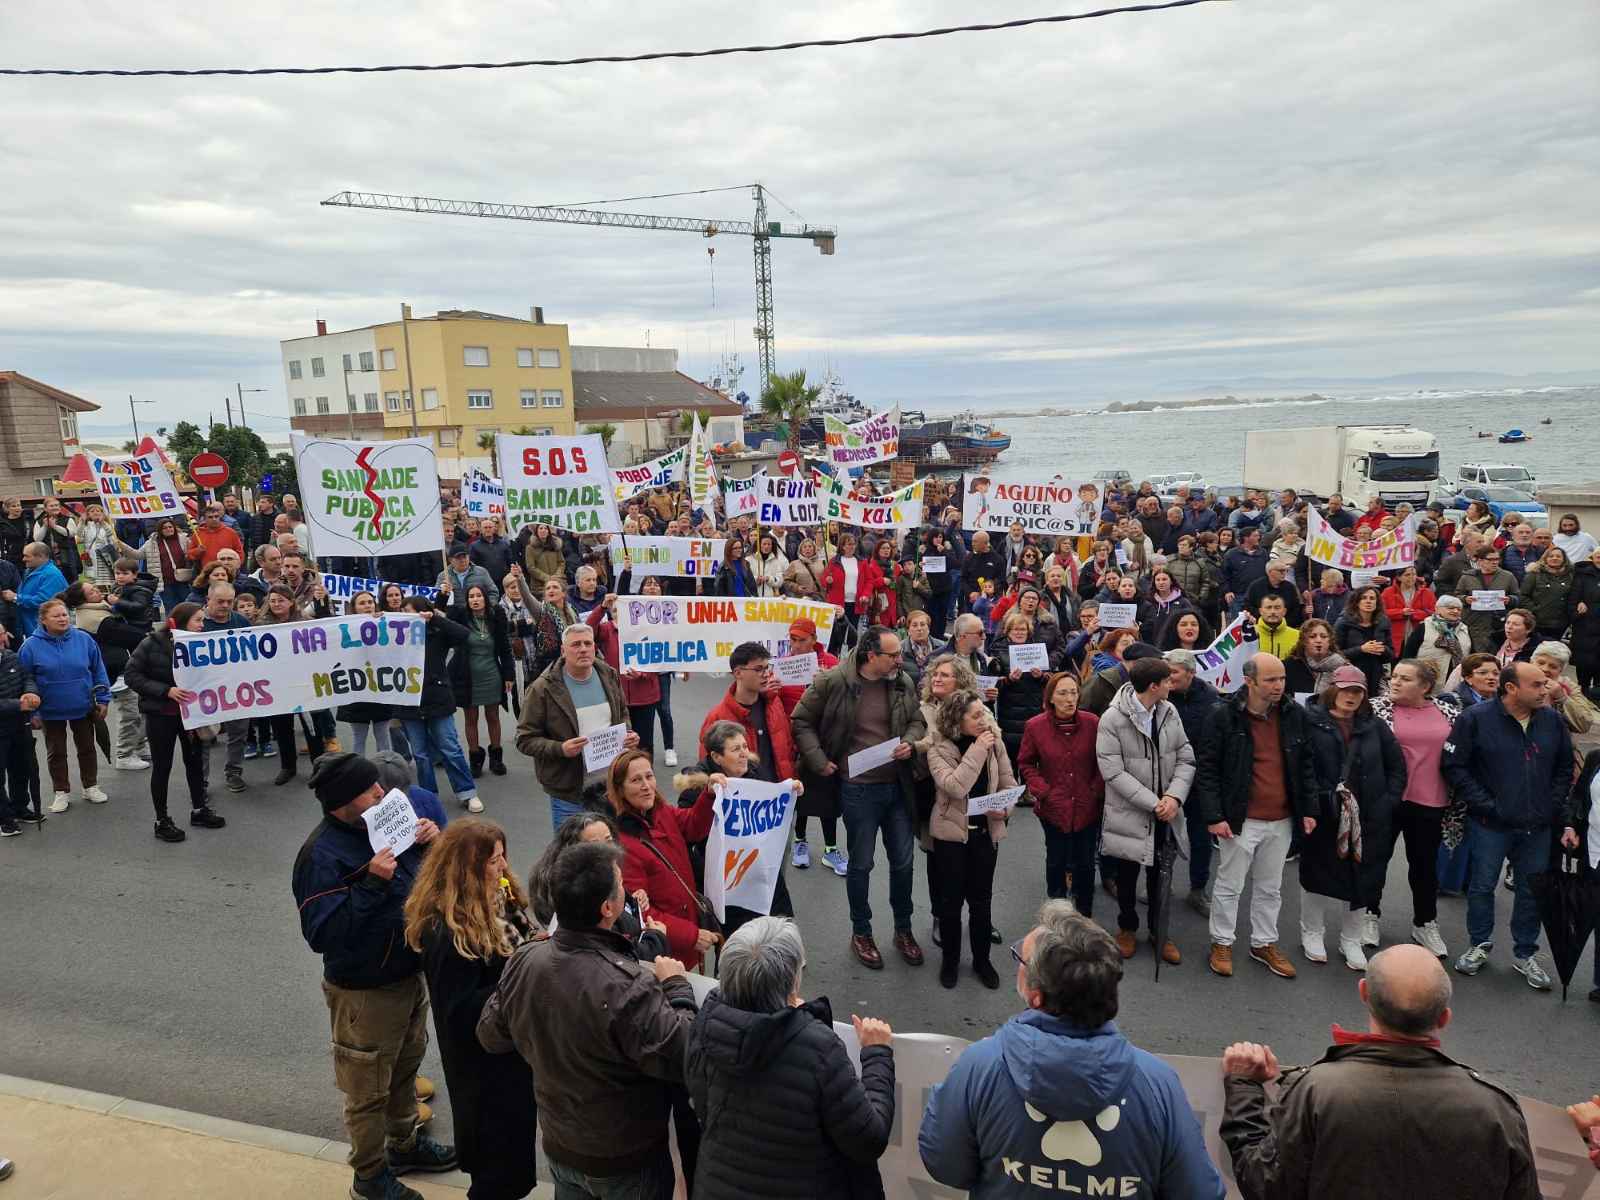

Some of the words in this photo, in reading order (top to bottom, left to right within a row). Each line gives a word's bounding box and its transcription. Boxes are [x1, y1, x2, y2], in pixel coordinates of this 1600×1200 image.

[100, 474, 156, 494] QUERE
[616, 466, 652, 483] POBO
[506, 485, 605, 511] SANIDADE
[994, 482, 1073, 503] AGUIÑO
[761, 503, 781, 522] EN
[789, 504, 823, 522] LOIT
[828, 498, 850, 519] SE
[1012, 502, 1052, 515] QUER
[988, 515, 1075, 533] MEDIC@S
[690, 541, 712, 557] EN
[628, 600, 679, 626] POR
[687, 601, 738, 624] UNHA
[744, 601, 834, 629] SANIDADE
[291, 626, 327, 655] NA
[623, 636, 709, 664] PÚBLICA
[179, 679, 274, 720] POLOS
[1002, 1157, 1142, 1198] KELME
